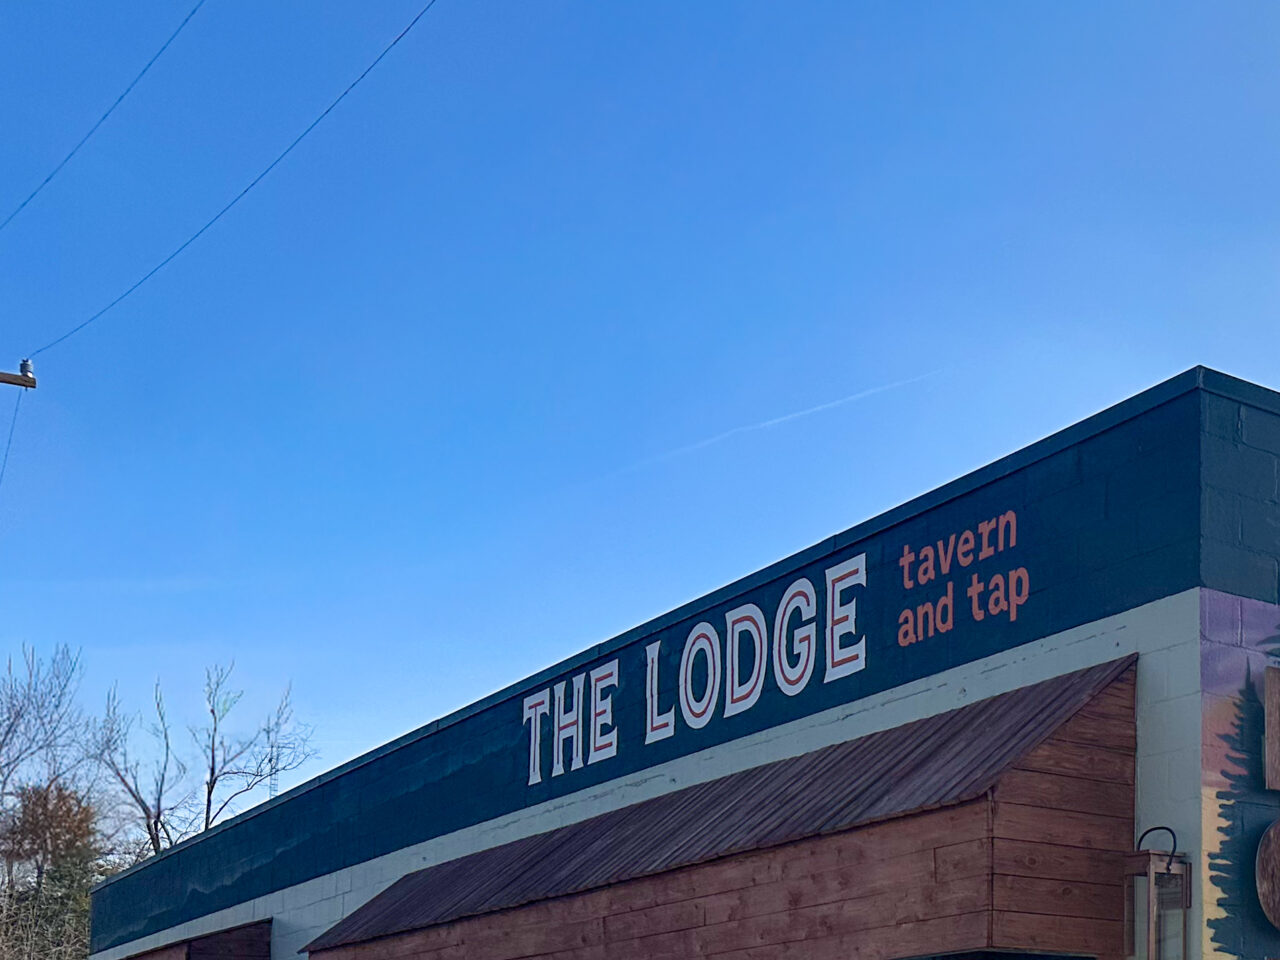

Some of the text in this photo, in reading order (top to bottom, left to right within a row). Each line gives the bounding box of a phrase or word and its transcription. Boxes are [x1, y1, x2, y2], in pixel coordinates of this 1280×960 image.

[899, 510, 1017, 590] tavern
[897, 567, 1030, 647] and tap
[522, 552, 867, 786] THE LODGE
